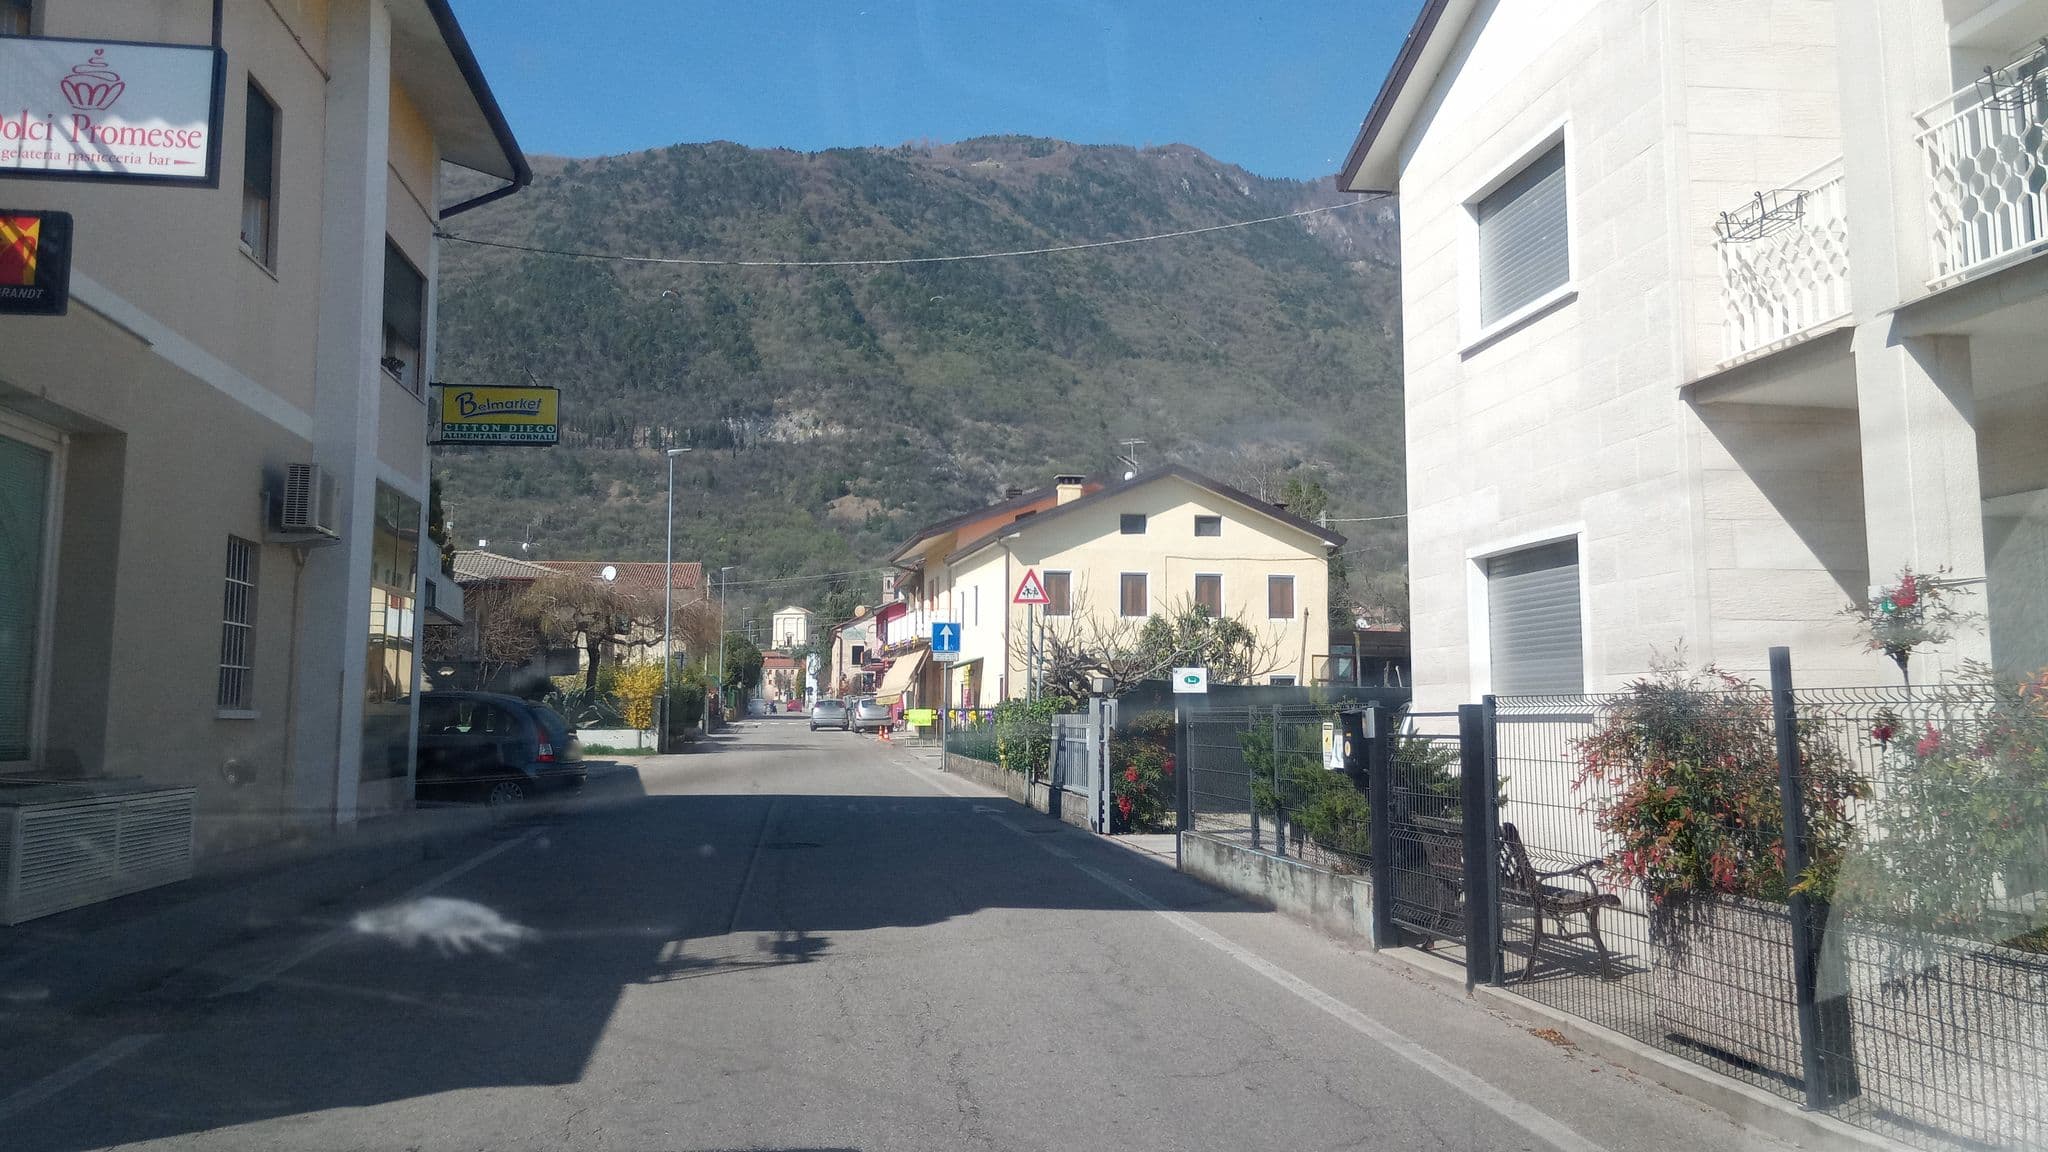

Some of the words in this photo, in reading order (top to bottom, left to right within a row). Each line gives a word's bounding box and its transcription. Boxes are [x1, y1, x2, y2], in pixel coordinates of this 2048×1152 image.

[0, 109, 53, 142] olci
[71, 113, 202, 149] Promesse
[1, 147, 61, 162] gelateria
[67, 151, 142, 165] pasticceria
[148, 152, 169, 166] bar
[0, 287, 45, 299] RANDT
[454, 392, 542, 417] Belmarket
[444, 423, 501, 433] CITTON
[509, 424, 555, 433] DIEGO
[443, 432, 502, 440] ALIMENTARI
[510, 432, 555, 441] GIORNALI
